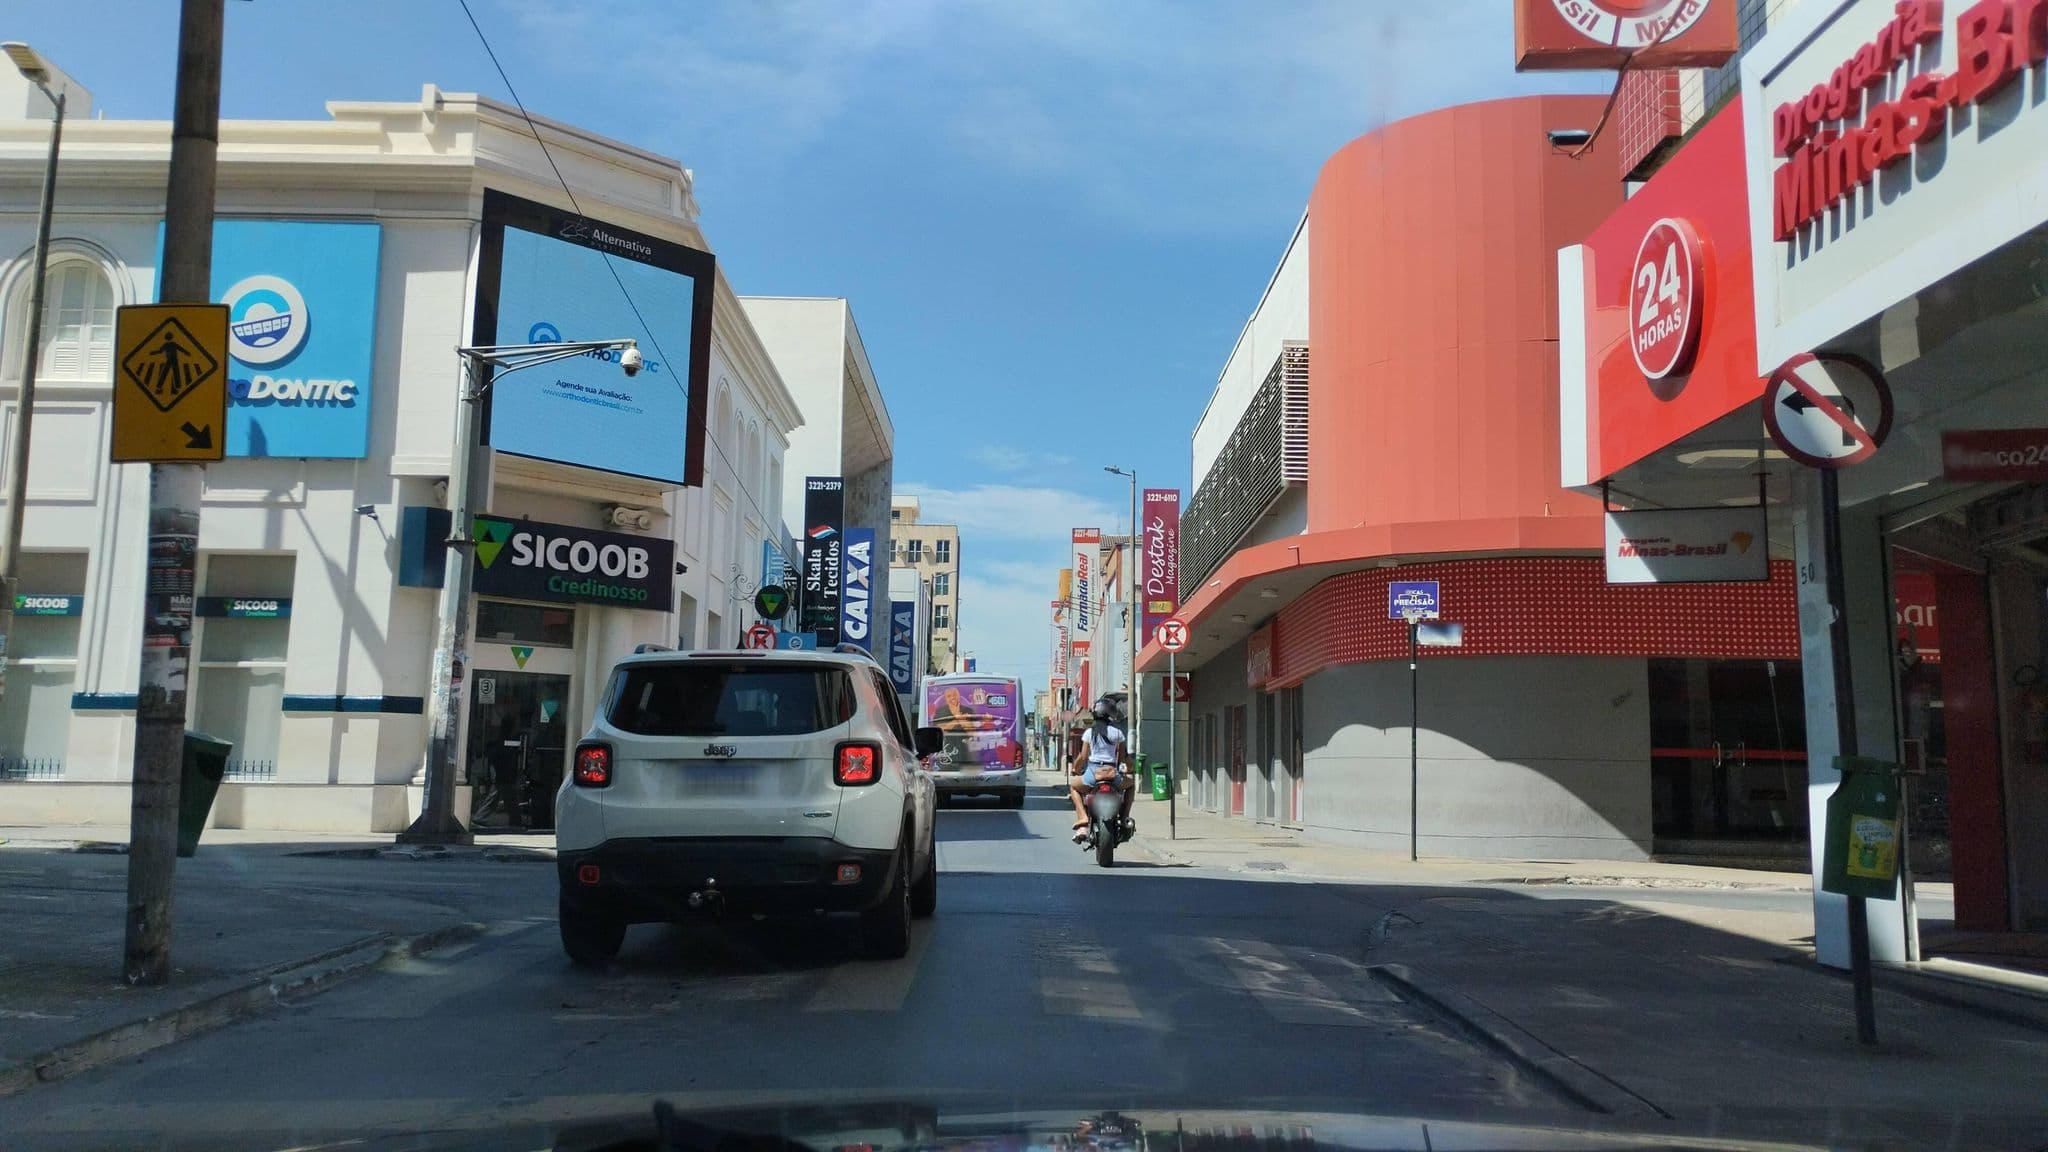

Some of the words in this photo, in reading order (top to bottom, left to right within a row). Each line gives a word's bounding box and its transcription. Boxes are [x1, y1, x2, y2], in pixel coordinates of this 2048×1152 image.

[1557, 0, 1600, 32] sil
[1773, 0, 1936, 157] Drogaria
[592, 229, 652, 255] Alternativa
[1638, 241, 1681, 328] 24
[1639, 307, 1682, 354] HORAS
[228, 375, 358, 401] ODONTIC
[555, 380, 584, 392] Agende
[585, 386, 597, 394] sua
[808, 482, 842, 490] 3221-2379
[1146, 494, 1177, 502] 3221-6110
[511, 532, 650, 579] SICOOB
[1147, 515, 1165, 596] Destak
[1618, 543, 1728, 558] Minas-Brasil
[1621, 537, 1671, 545] Drogaria
[806, 549, 822, 592] Skala
[824, 540, 840, 599] Tecidos
[1166, 528, 1178, 585] Magazine
[549, 575, 648, 601] Credinosso
[845, 541, 870, 640] CAIXA
[25, 597, 69, 609] SICOOB
[232, 600, 278, 611] SICOOB
[893, 611, 912, 684] CAIXA
[703, 743, 738, 758] Jeep
